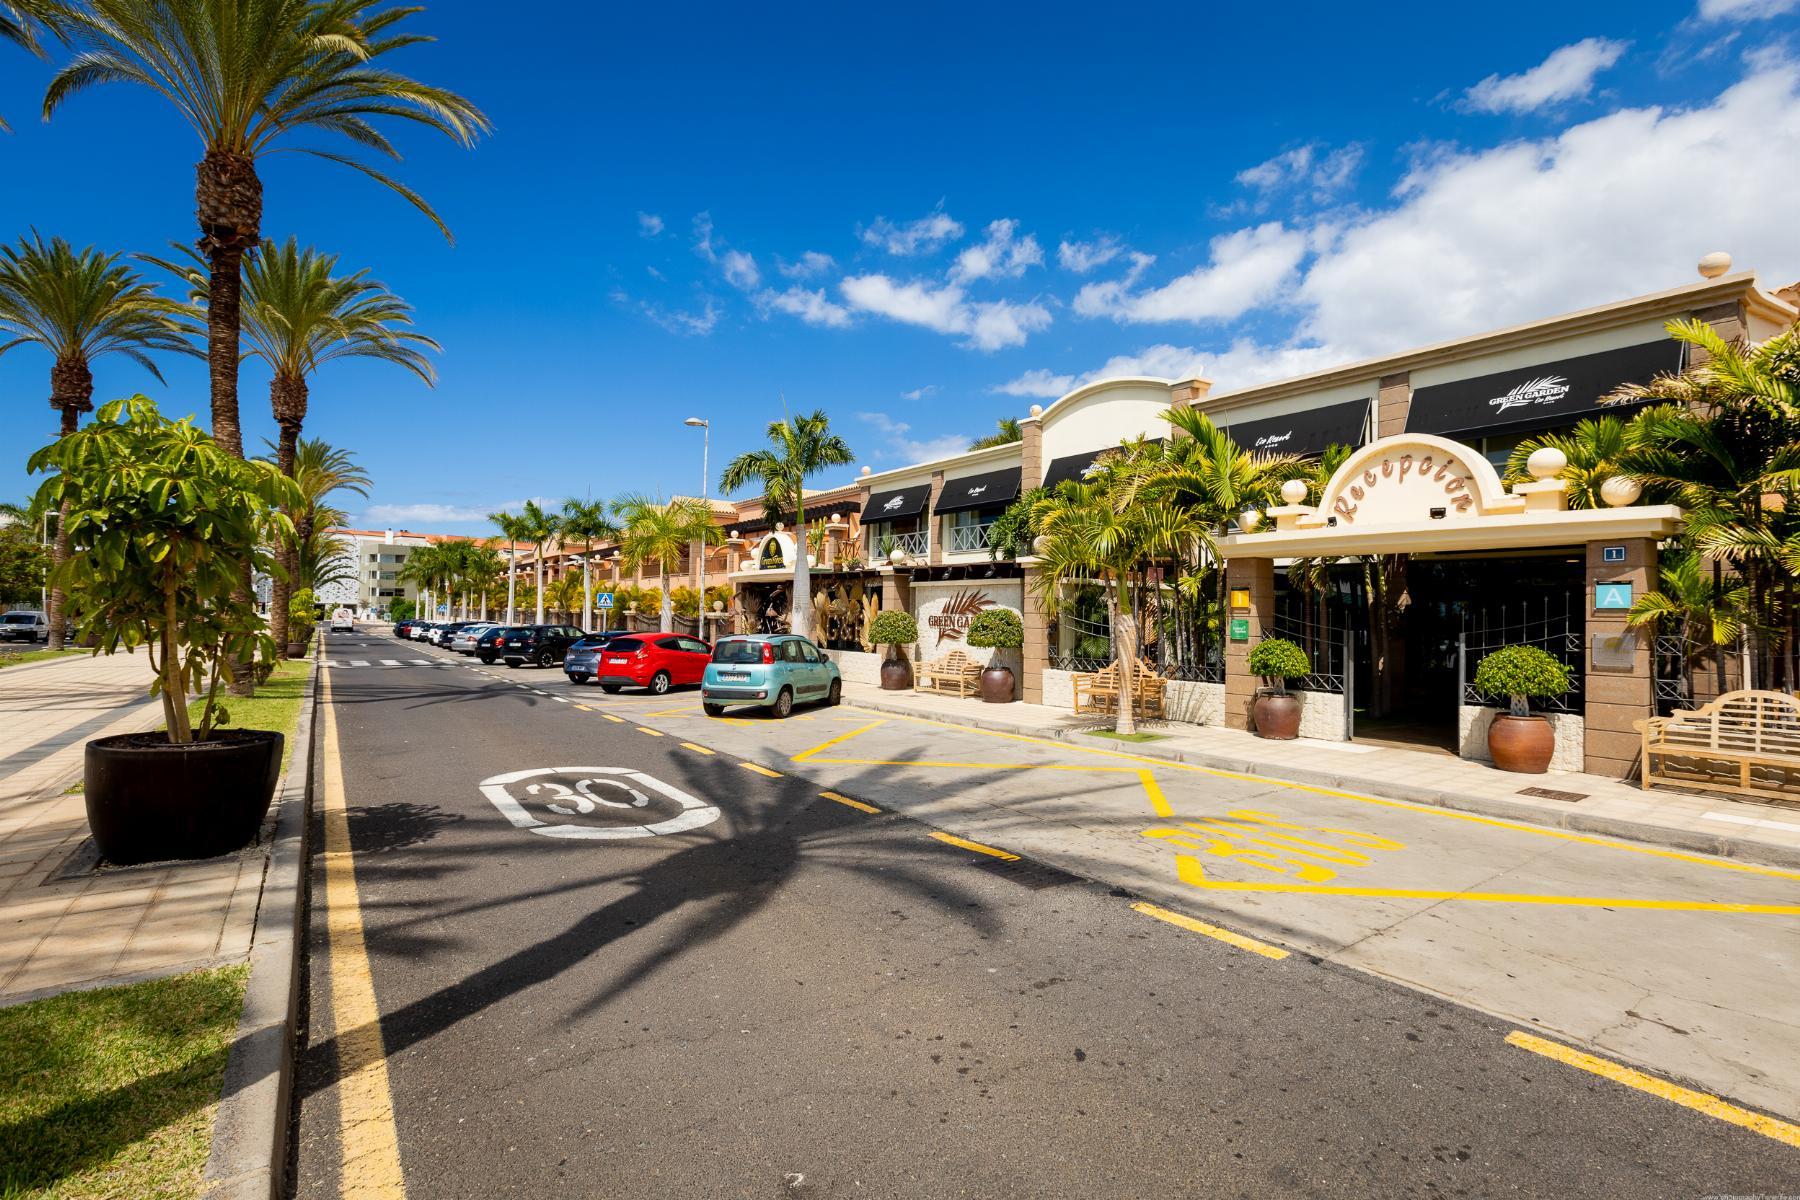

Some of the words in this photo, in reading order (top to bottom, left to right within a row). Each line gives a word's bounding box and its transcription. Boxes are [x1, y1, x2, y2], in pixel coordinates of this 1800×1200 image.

[1489, 393, 1523, 406] GREEN
[1524, 385, 1570, 399] GARDEN
[1266, 430, 1292, 445] Resort
[1333, 453, 1475, 524] Recepción
[1611, 549, 1617, 559] 1
[1603, 587, 1624, 606] A
[928, 615, 956, 628] GREEN
[525, 778, 650, 815] 30
